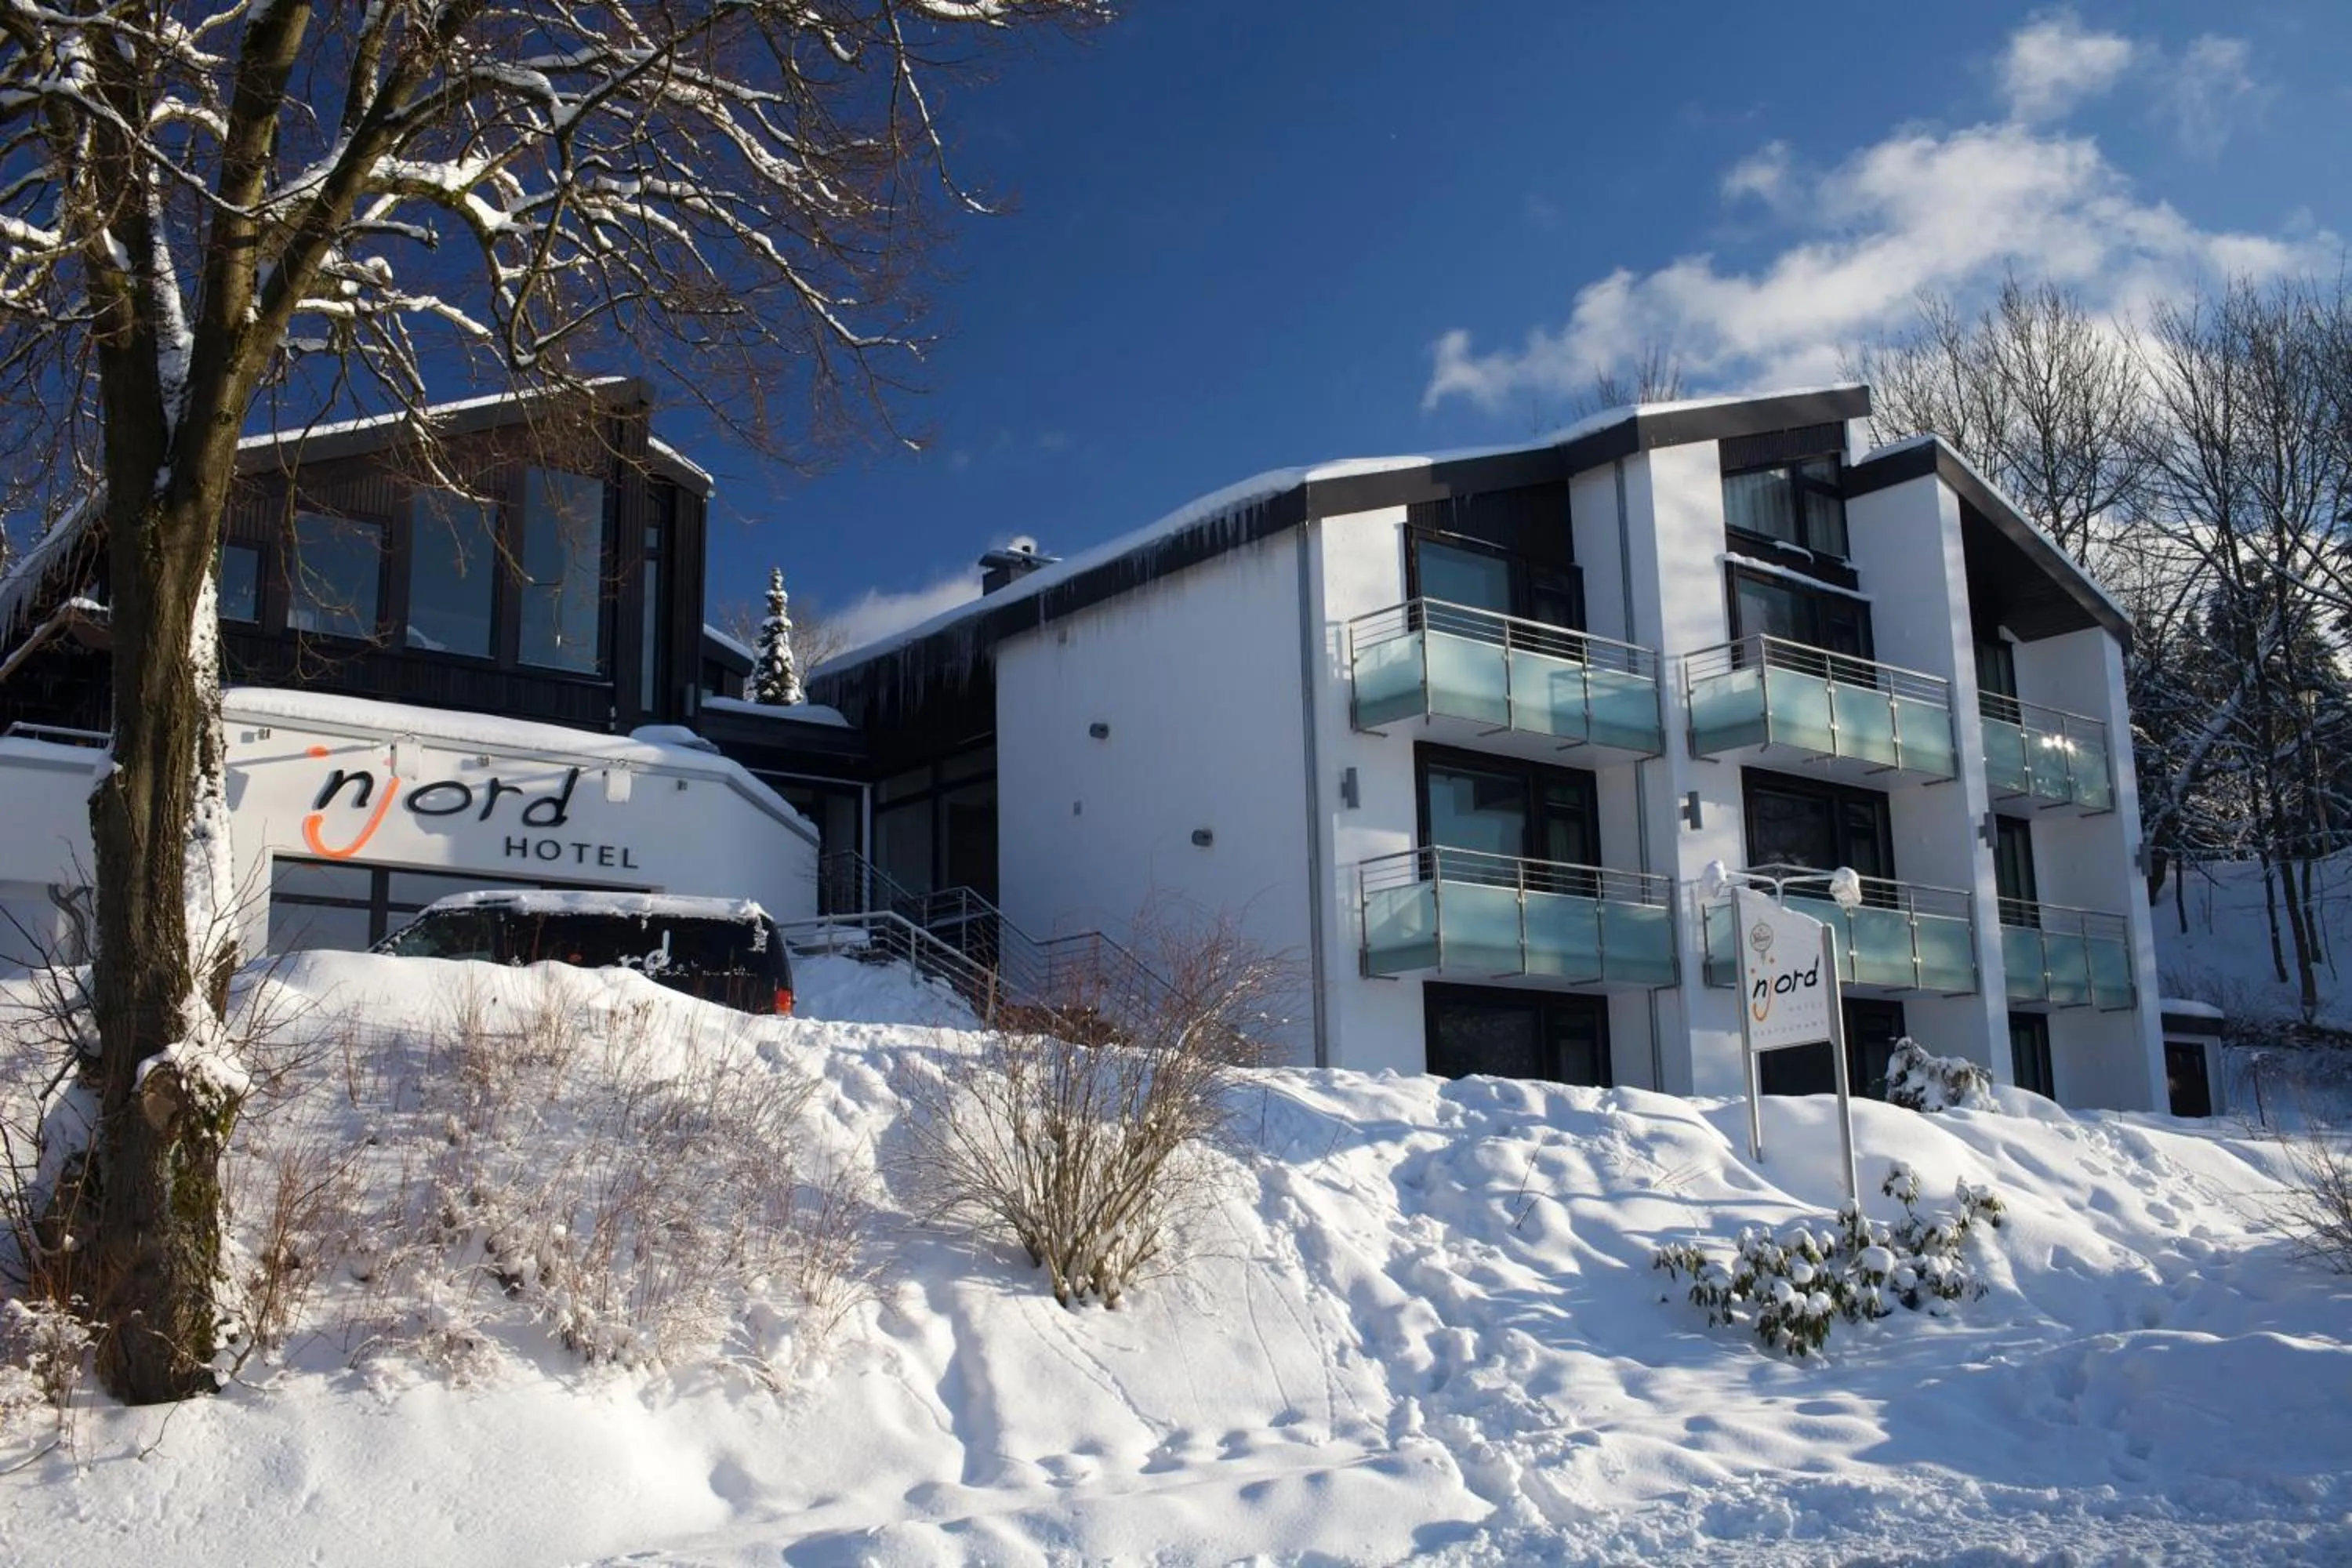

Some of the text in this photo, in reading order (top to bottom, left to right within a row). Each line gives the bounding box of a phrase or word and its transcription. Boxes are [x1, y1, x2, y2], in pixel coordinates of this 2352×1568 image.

[303, 756, 579, 858] njord
[505, 836, 639, 869] HOTEL
[1752, 955, 1820, 1021] njord
